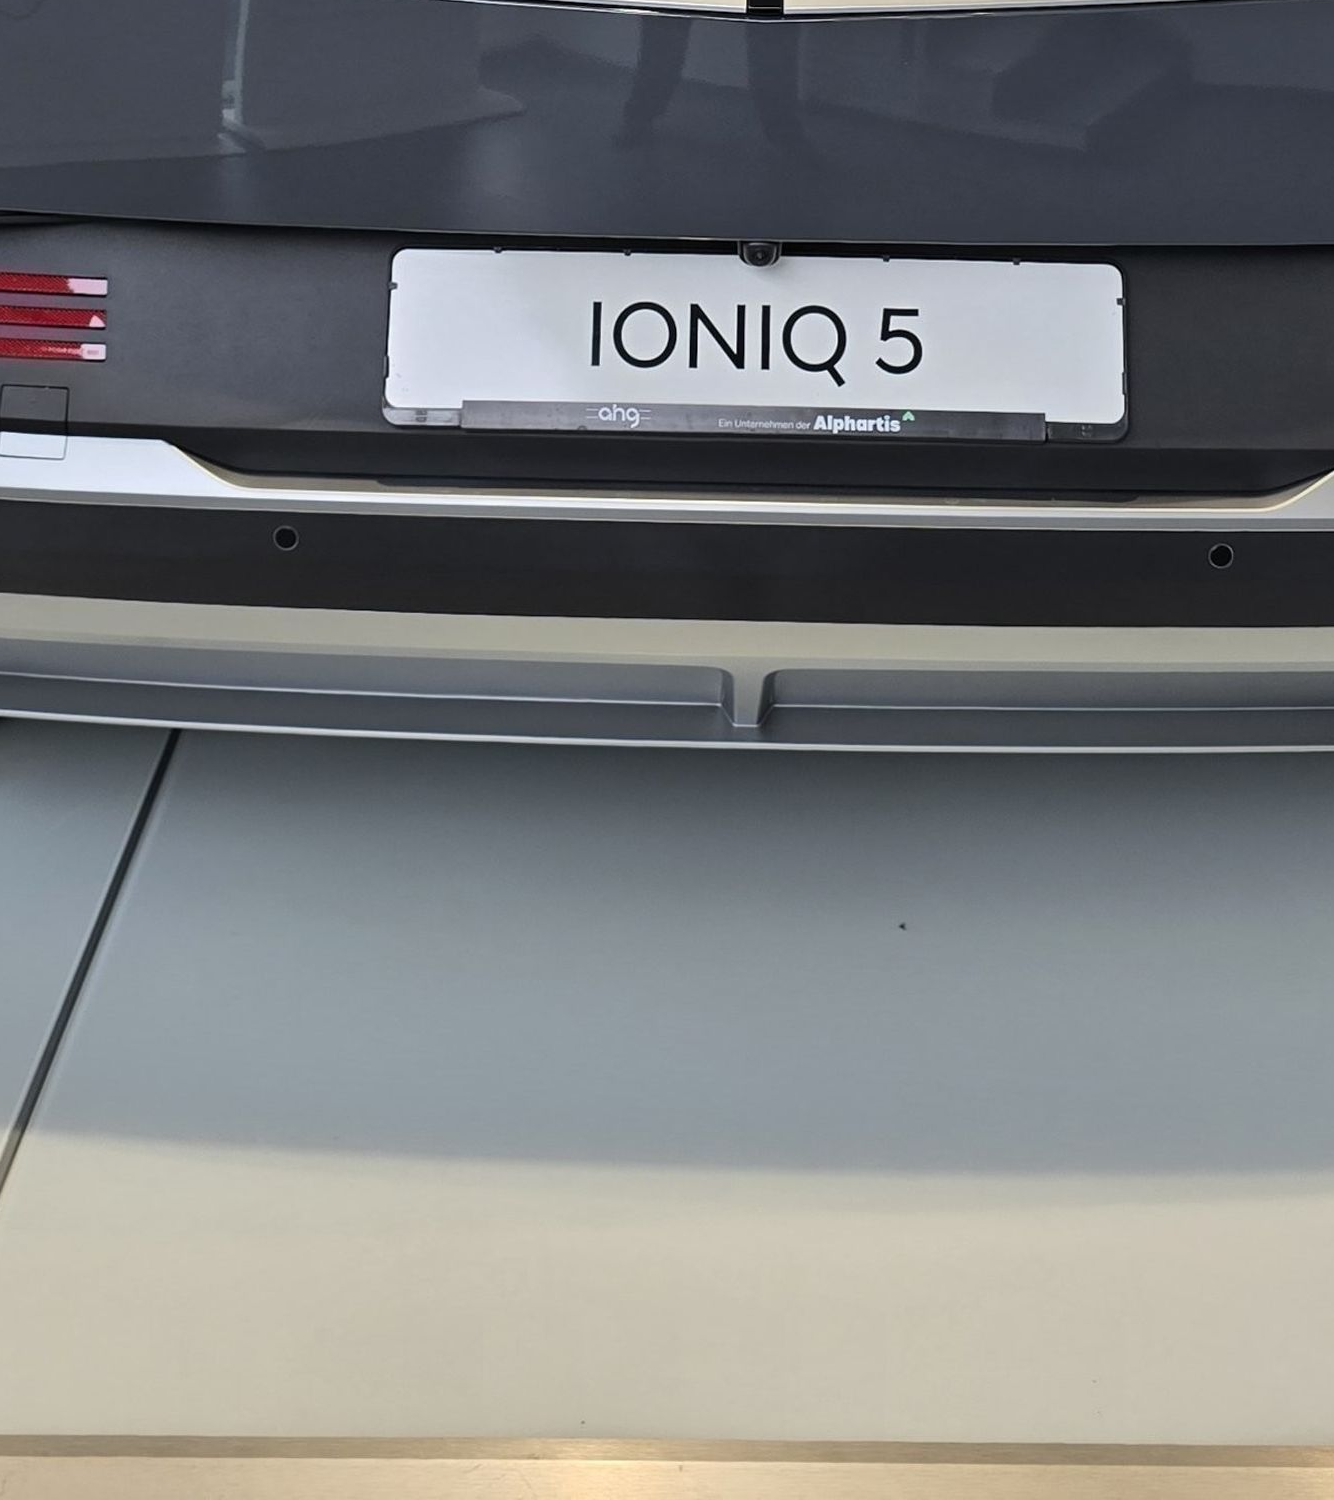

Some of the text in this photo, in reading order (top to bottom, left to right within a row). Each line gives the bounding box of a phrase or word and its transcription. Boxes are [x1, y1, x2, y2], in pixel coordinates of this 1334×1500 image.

[591, 301, 923, 387] IONIQ 5
[598, 404, 640, 429] ahg
[718, 414, 901, 435] Ein Unternehmen der Alphartis
